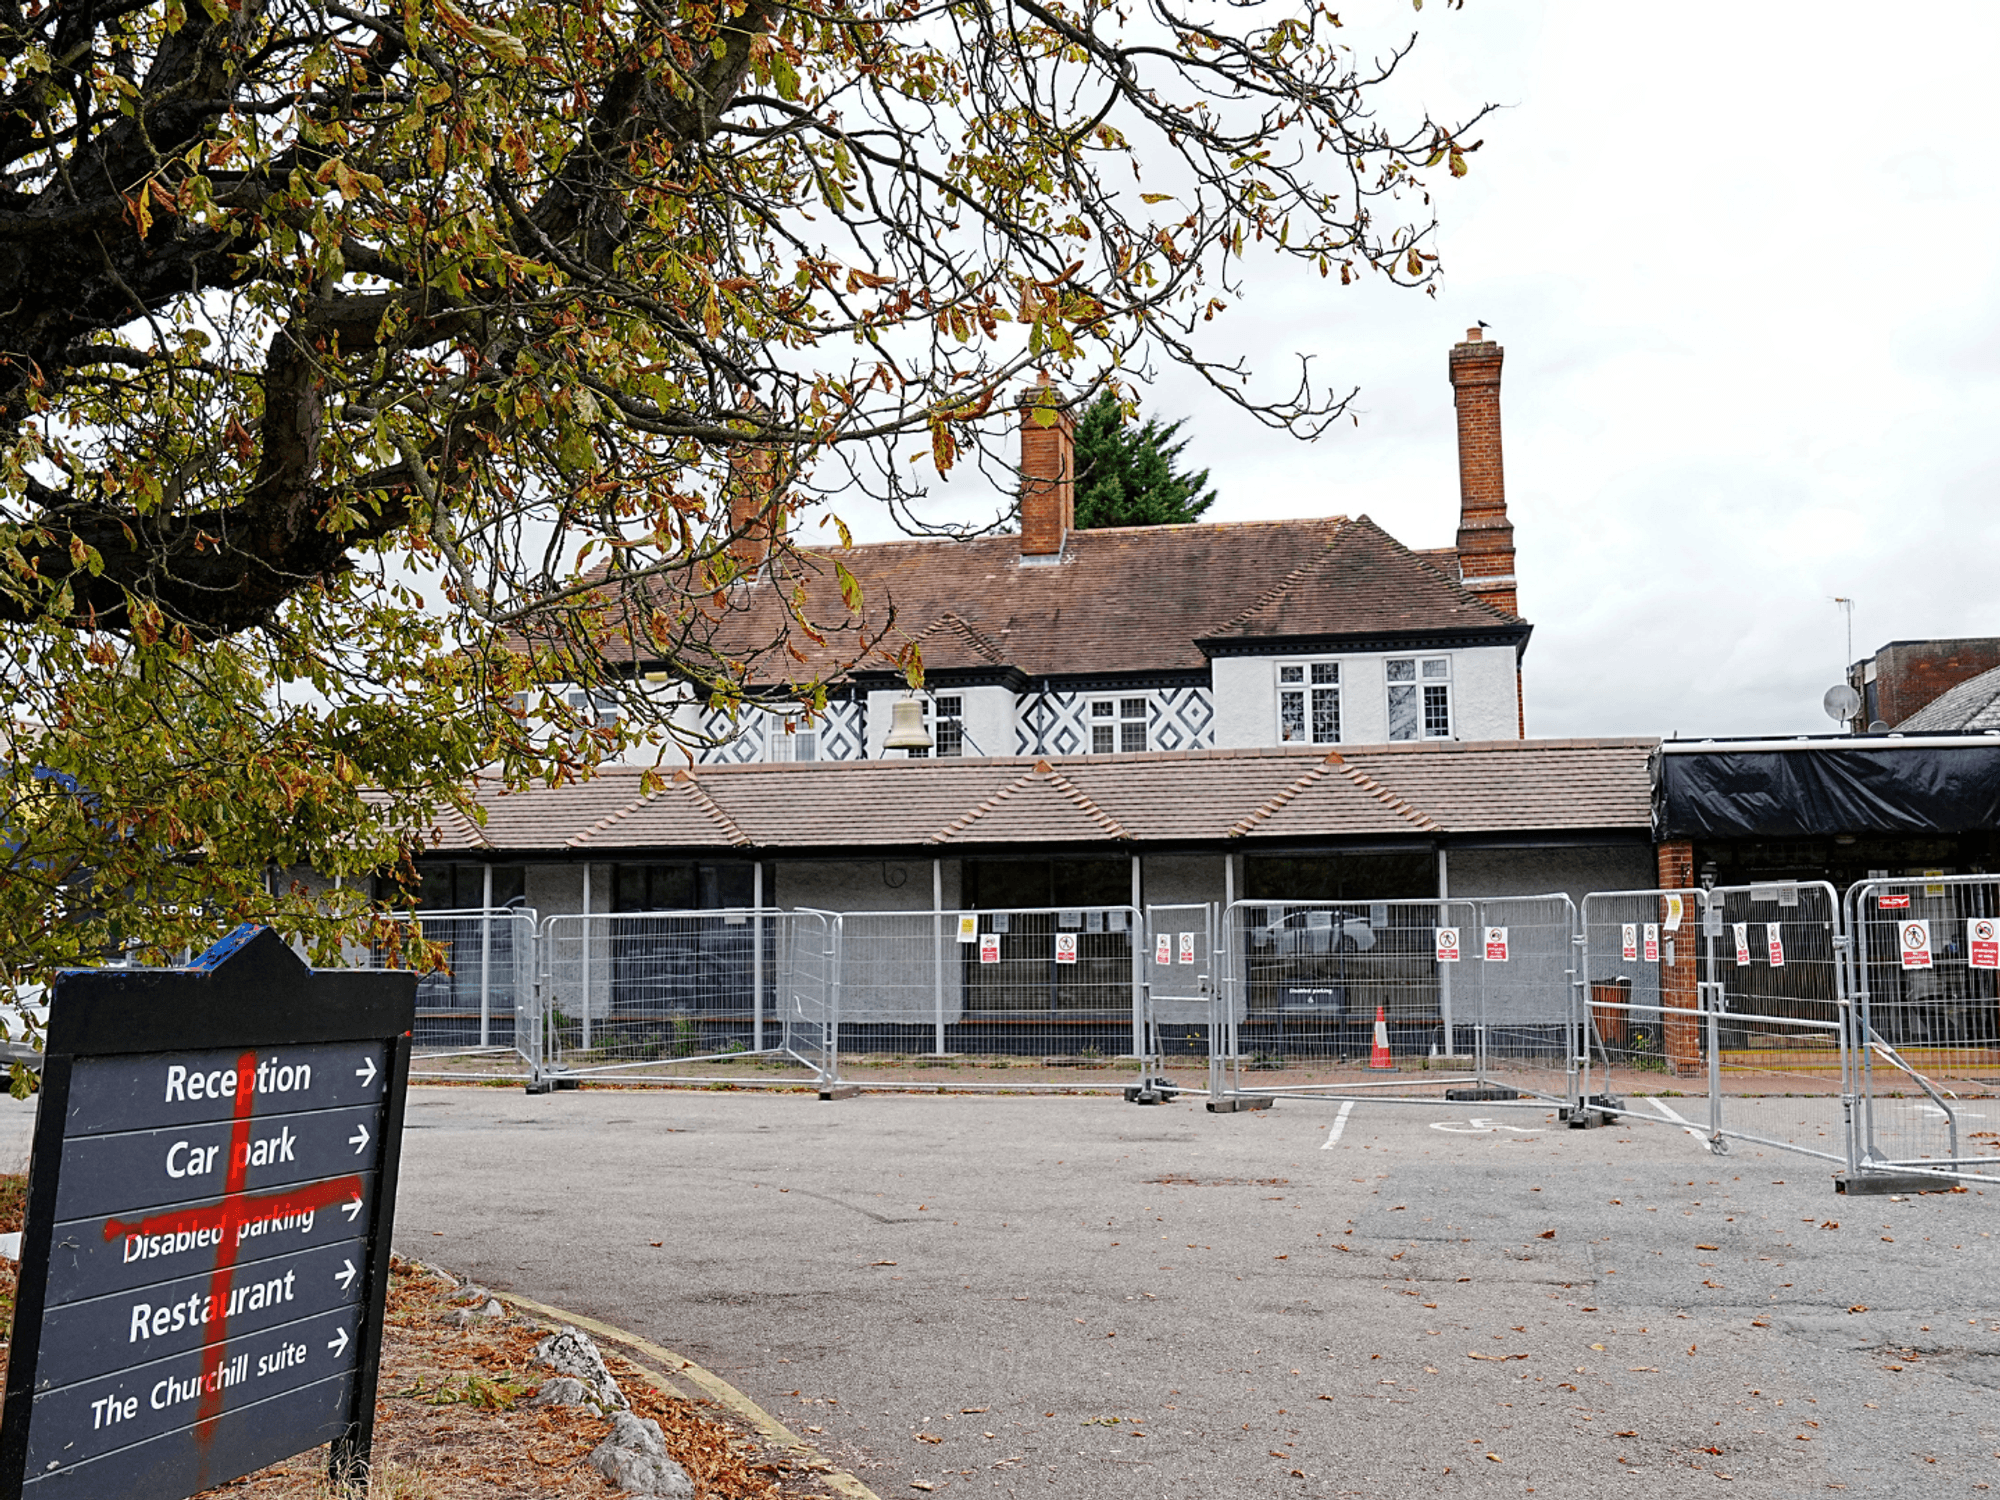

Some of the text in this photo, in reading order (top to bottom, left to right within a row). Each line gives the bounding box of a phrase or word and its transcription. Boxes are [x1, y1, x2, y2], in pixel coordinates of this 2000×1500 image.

[165, 1057, 311, 1106] Reception
[166, 1125, 297, 1180] Car park
[123, 1203, 316, 1264] Disabled parking
[129, 1269, 296, 1343] Restaurant
[91, 1341, 307, 1430] The Churchill suite
